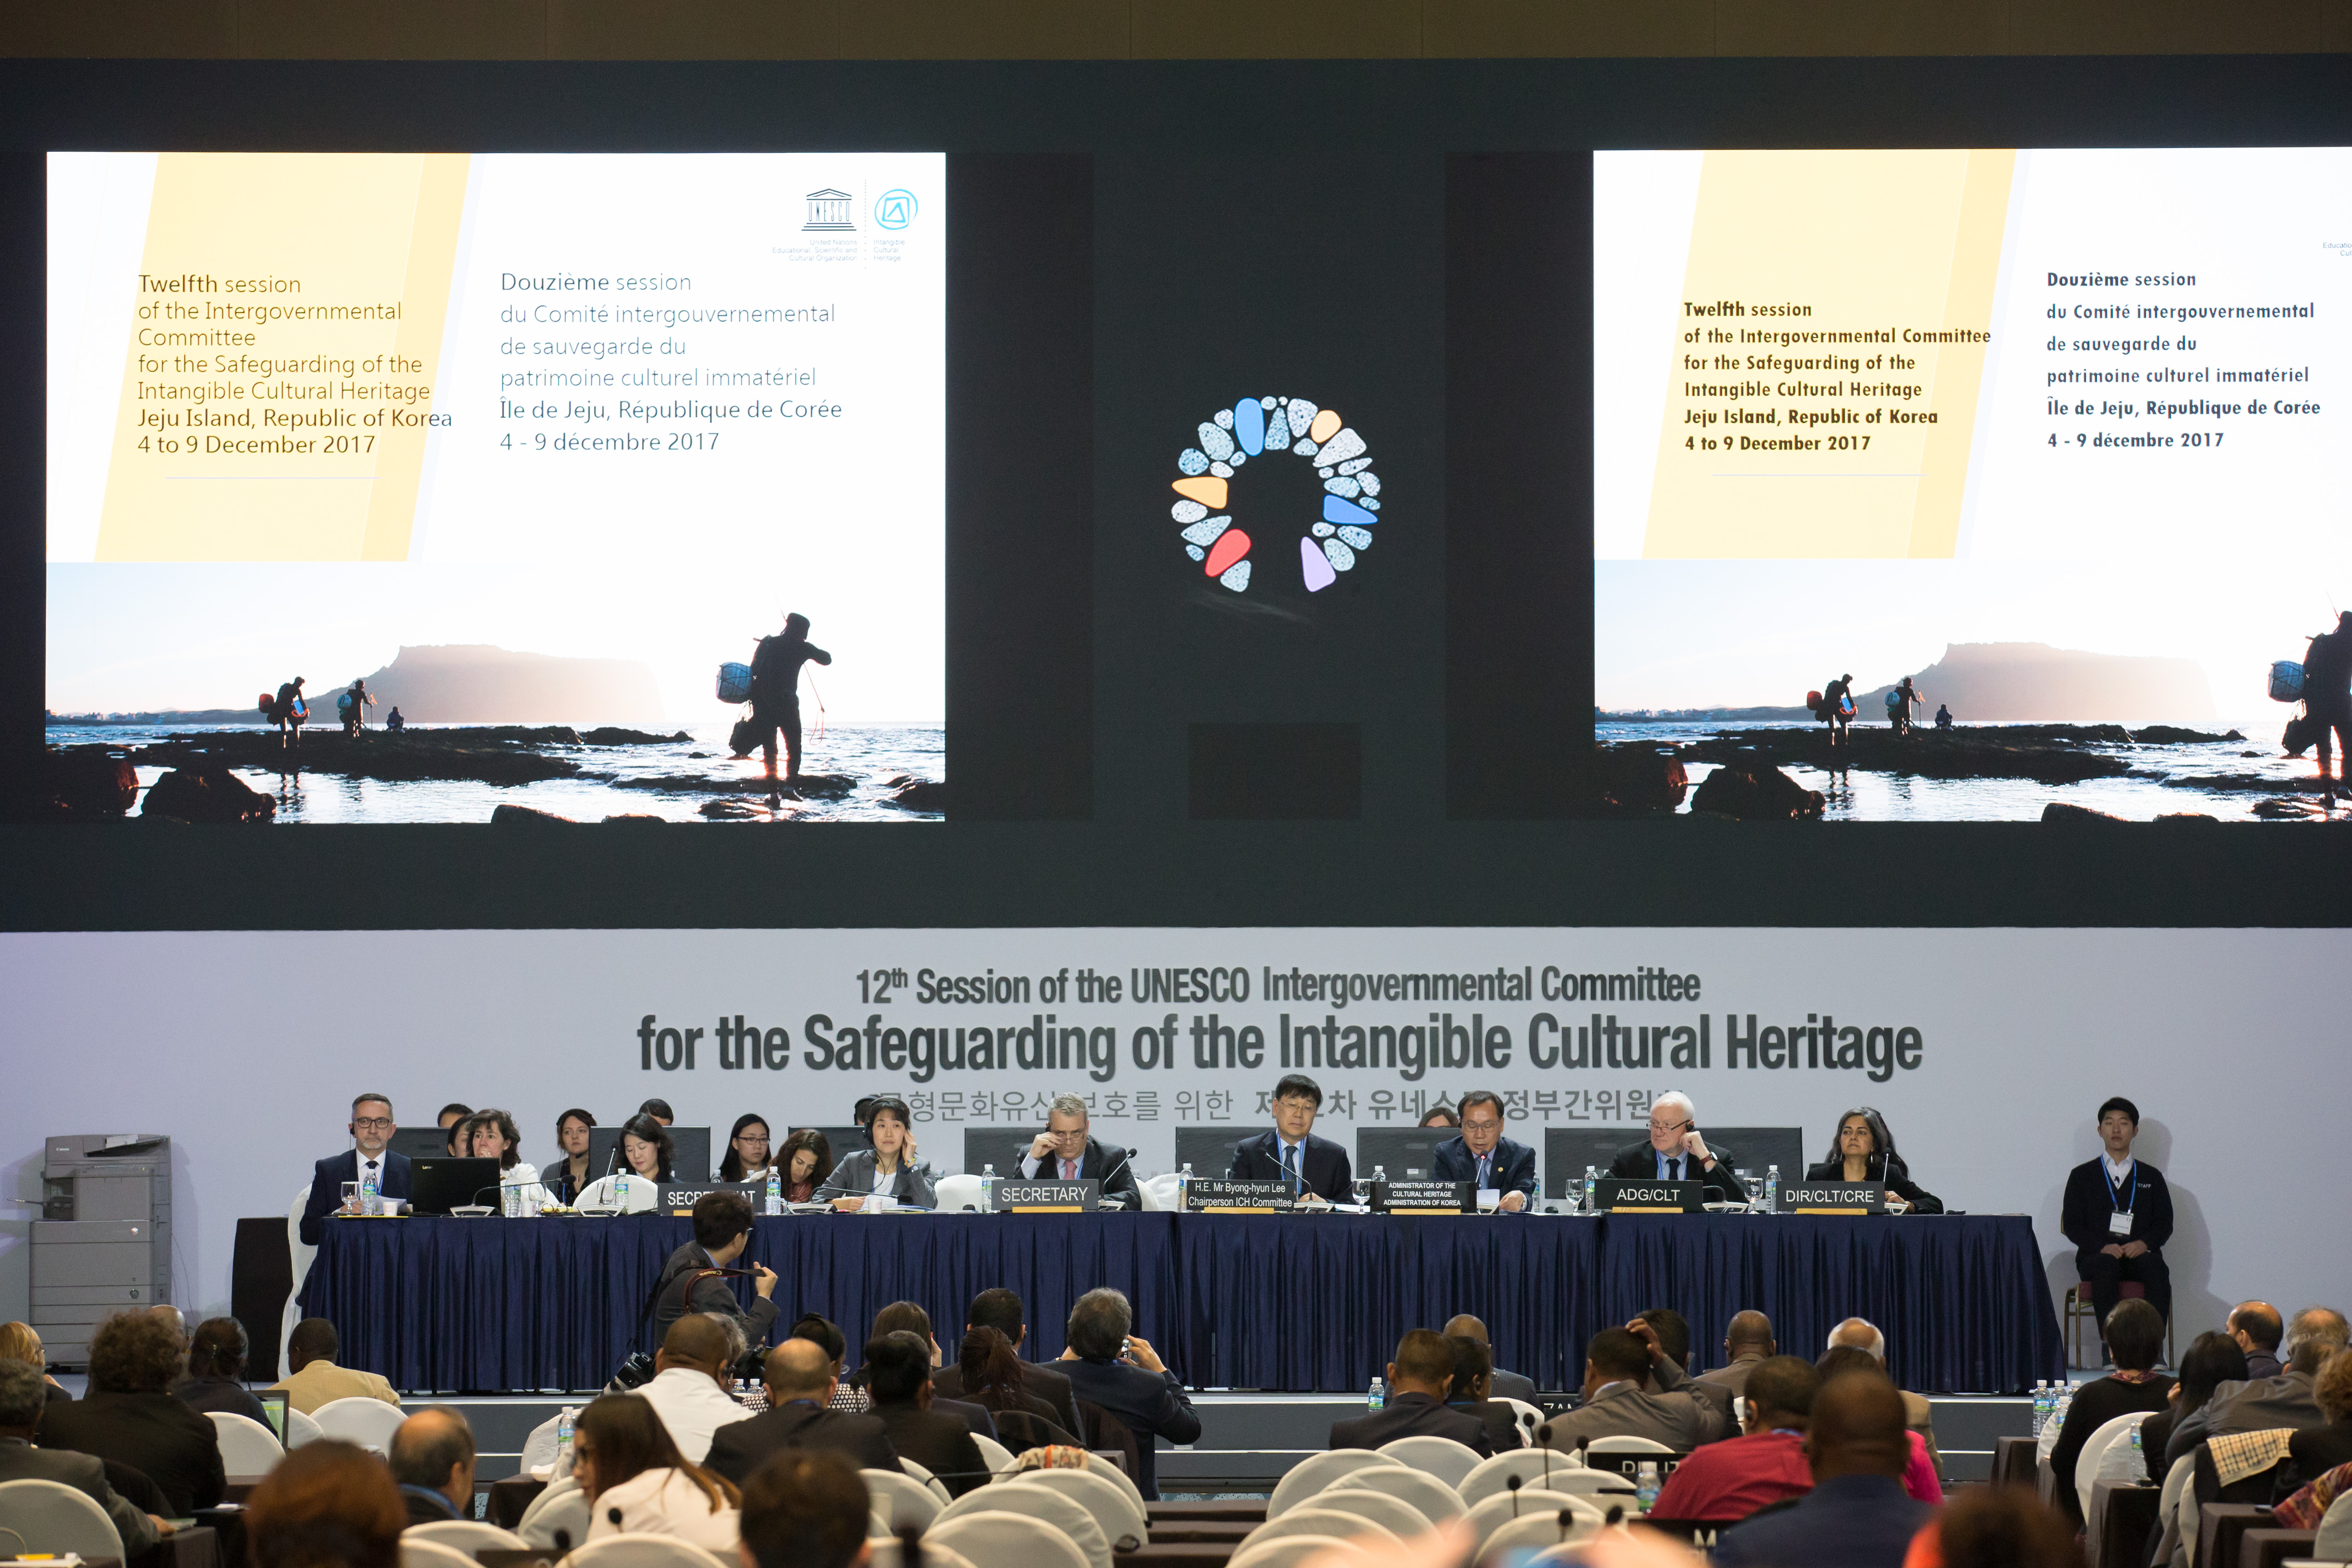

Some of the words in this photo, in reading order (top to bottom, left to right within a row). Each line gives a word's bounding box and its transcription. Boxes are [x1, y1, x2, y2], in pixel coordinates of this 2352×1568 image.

[809, 201, 849, 221] UNESCO
[139, 274, 217, 292] Twelfth
[225, 275, 300, 293] session
[503, 273, 609, 290] Douzième
[617, 273, 690, 290] session
[2048, 272, 2128, 286] Douzième
[2135, 272, 2195, 286] session
[139, 301, 160, 319] of
[165, 301, 199, 319] the
[206, 302, 401, 325] Intergovernmental
[501, 304, 525, 322] du
[535, 304, 608, 322] Comité
[617, 304, 834, 327] intergouvernemental
[1684, 301, 1744, 316] Twelfth
[1751, 302, 1811, 316] session
[2047, 304, 2066, 318] du
[2074, 304, 2130, 318] Comité
[2138, 302, 2313, 322] intergouvernemental
[139, 328, 255, 346] Committee
[1684, 327, 1700, 343] of
[1708, 327, 1733, 343] the
[1741, 327, 1895, 347] Intergovernmental
[1903, 328, 1991, 343] Committee
[2047, 336, 2065, 350] de
[2073, 335, 2169, 355] sauvegarde
[2177, 335, 2196, 350] du
[501, 337, 525, 354] de
[534, 337, 652, 360] sauvegarde
[660, 337, 684, 354] du
[138, 354, 168, 372] for
[174, 354, 207, 372] the
[215, 354, 354, 378] Safeguarding
[362, 355, 383, 373] of
[389, 355, 422, 373] the
[1684, 354, 1708, 370] for
[1714, 354, 1740, 370] the
[1747, 354, 1859, 374] Safeguarding
[1866, 354, 1882, 369] of
[1889, 354, 1915, 369] the
[502, 369, 614, 391] patrimoine
[622, 368, 697, 386] culturel
[707, 368, 815, 385] immatériel
[2048, 369, 2140, 387] patrimoine
[2147, 367, 2209, 382] culturel
[2217, 367, 2308, 382] immatériel
[138, 381, 244, 404] Intangible
[252, 381, 332, 399] Cultural
[342, 382, 430, 405] Heritage
[1685, 381, 1770, 401] Intangible
[1777, 380, 1842, 396] Cultural
[1851, 382, 1922, 400] Heritage
[500, 396, 524, 418] Île
[533, 401, 557, 418] de
[564, 401, 609, 423] Jeju,
[620, 400, 740, 423] République
[748, 400, 772, 418] de
[780, 400, 841, 417] Corée
[2048, 396, 2068, 414] Île
[2075, 400, 2094, 414] de
[2101, 401, 2139, 419] Jeju,
[2147, 399, 2241, 419] République
[2248, 399, 2267, 414] de
[2274, 400, 2320, 414] Corée
[138, 408, 178, 432] Jeju
[186, 408, 255, 429] Island,
[264, 408, 356, 432] Republic
[363, 408, 385, 426] of
[392, 409, 451, 426] Korea
[1684, 409, 1717, 428] Jeju
[1724, 408, 1782, 427] Island,
[1789, 408, 1859, 428] Republic
[1865, 408, 1882, 423] of
[1890, 409, 1938, 423] Korea
[138, 436, 150, 453] 4
[157, 437, 178, 453] to
[186, 436, 198, 453] 9
[207, 435, 316, 453] December
[323, 436, 375, 453] 2017
[500, 433, 512, 450] 4
[535, 433, 546, 450] 9
[554, 433, 660, 450] décembre
[668, 433, 718, 450] 2017
[1685, 436, 1694, 450] 4
[1701, 437, 1717, 450] to
[1723, 436, 1733, 450] 9
[1740, 435, 1821, 450] December
[1828, 436, 1871, 450] 2017
[2048, 433, 2057, 447] 4
[2077, 433, 2086, 447] 9
[2094, 432, 2174, 447] décembre
[2181, 433, 2224, 447] 2017
[857, 968, 908, 1004] 12th
[917, 968, 1030, 1004] Session
[1039, 968, 1068, 1004] of
[1076, 968, 1122, 1003] the
[1132, 967, 1250, 1003] UNESCO
[1264, 966, 1532, 1009] Intergovernmental
[1542, 965, 1701, 1001] Committee
[637, 1015, 703, 1071] for
[715, 1015, 790, 1071] the
[804, 1014, 1115, 1083] Safeguarding
[1132, 1014, 1178, 1070] of
[1190, 1014, 1264, 1068] the
[1278, 1013, 1512, 1081] Intangible
[1529, 1013, 1710, 1069] Cultural
[1727, 1013, 1922, 1083] Heritage
[1174, 1090, 1233, 1120] 위한
[1502, 1089, 1682, 1120] 정부간위원
[1002, 1187, 1088, 1201] SECRETARY
[1196, 1183, 1210, 1191] H.E.
[1214, 1183, 1223, 1191] Mr
[1226, 1183, 1269, 1195] Byong-hyun
[1272, 1183, 1285, 1192] Lee
[1617, 1189, 1680, 1201] ADG/CLT
[1786, 1190, 1874, 1202] DIR/CLT/CRE
[1188, 1197, 1233, 1208] Chairperson
[1236, 1197, 1250, 1207] ICH
[1252, 1197, 1292, 1207] Committee
